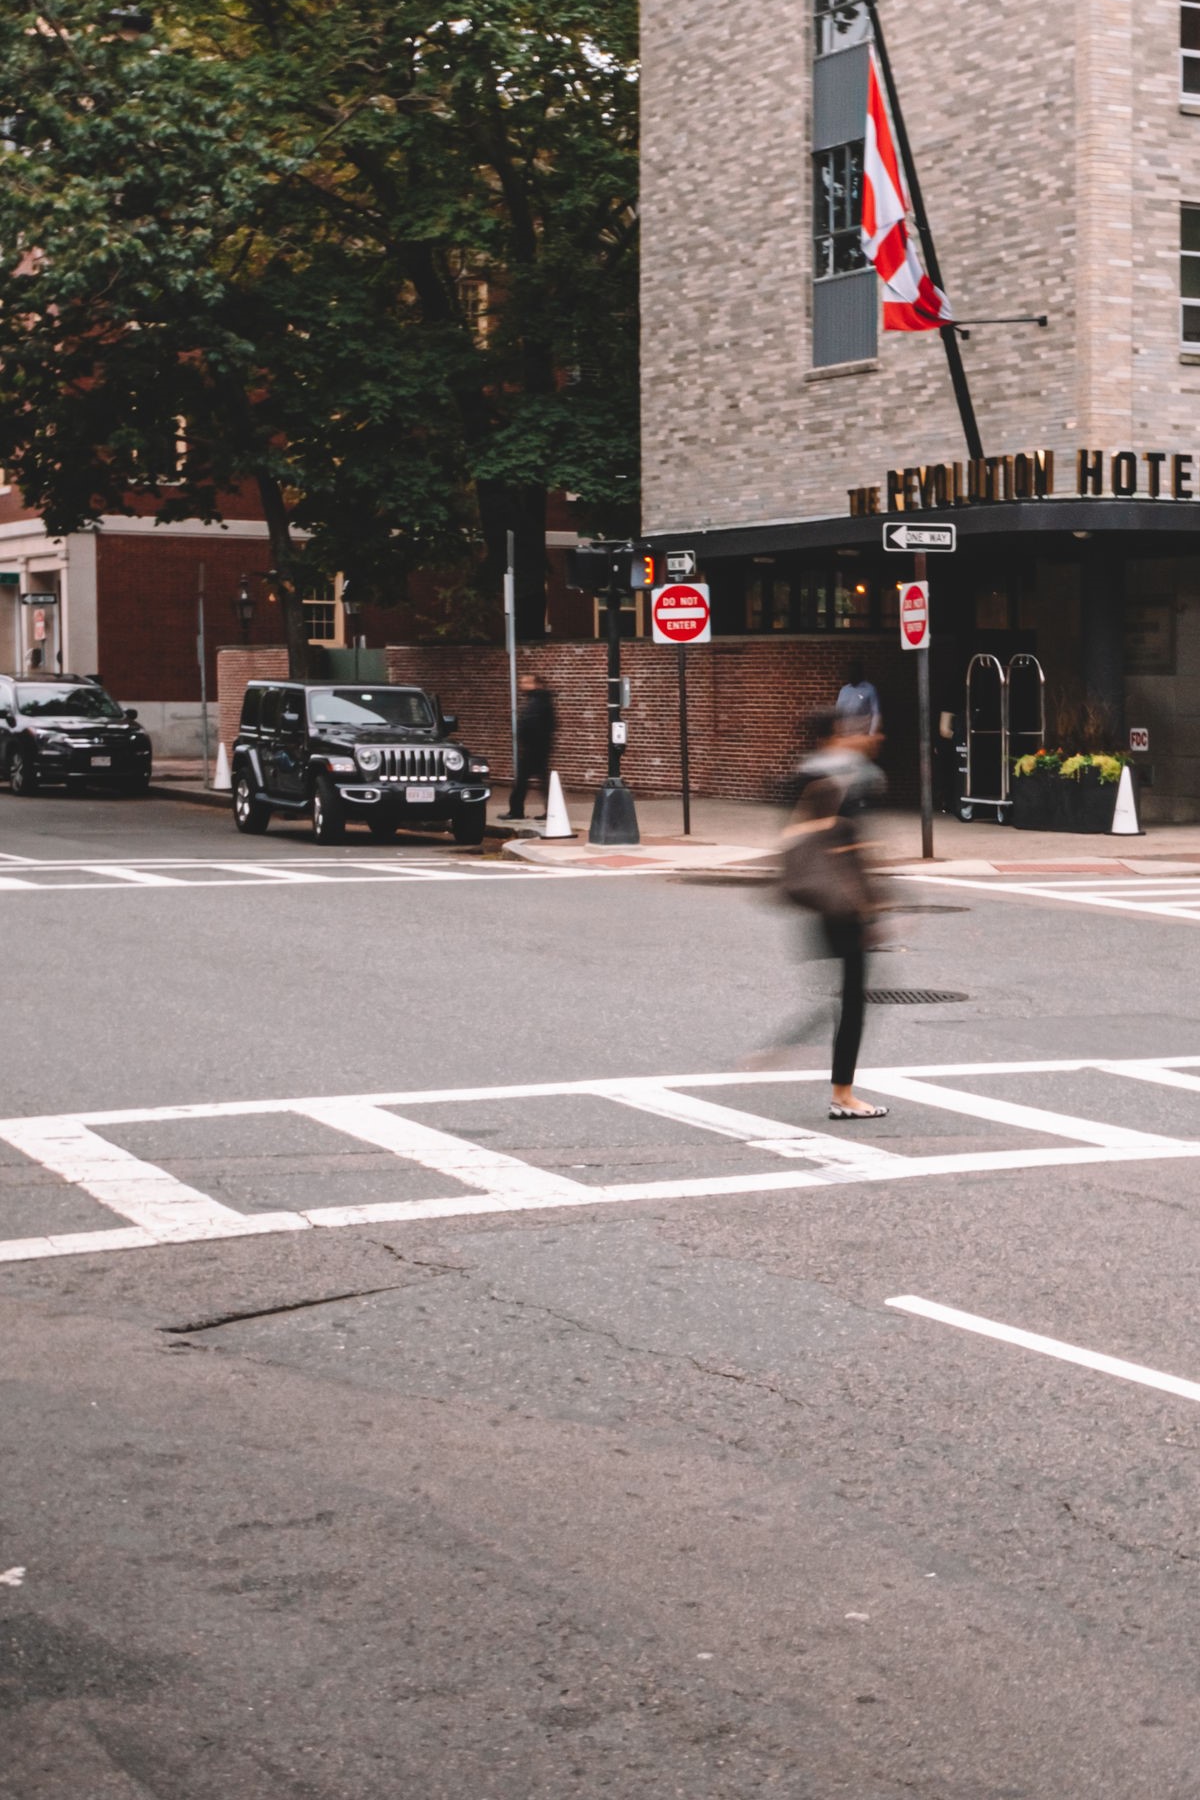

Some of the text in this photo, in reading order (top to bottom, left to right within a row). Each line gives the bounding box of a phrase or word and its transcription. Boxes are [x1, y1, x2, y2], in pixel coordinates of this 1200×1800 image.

[905, 532, 948, 543] ONE WAY
[662, 596, 699, 607] DO NOT
[666, 621, 697, 631] ENTER
[1131, 731, 1147, 747] FDC
